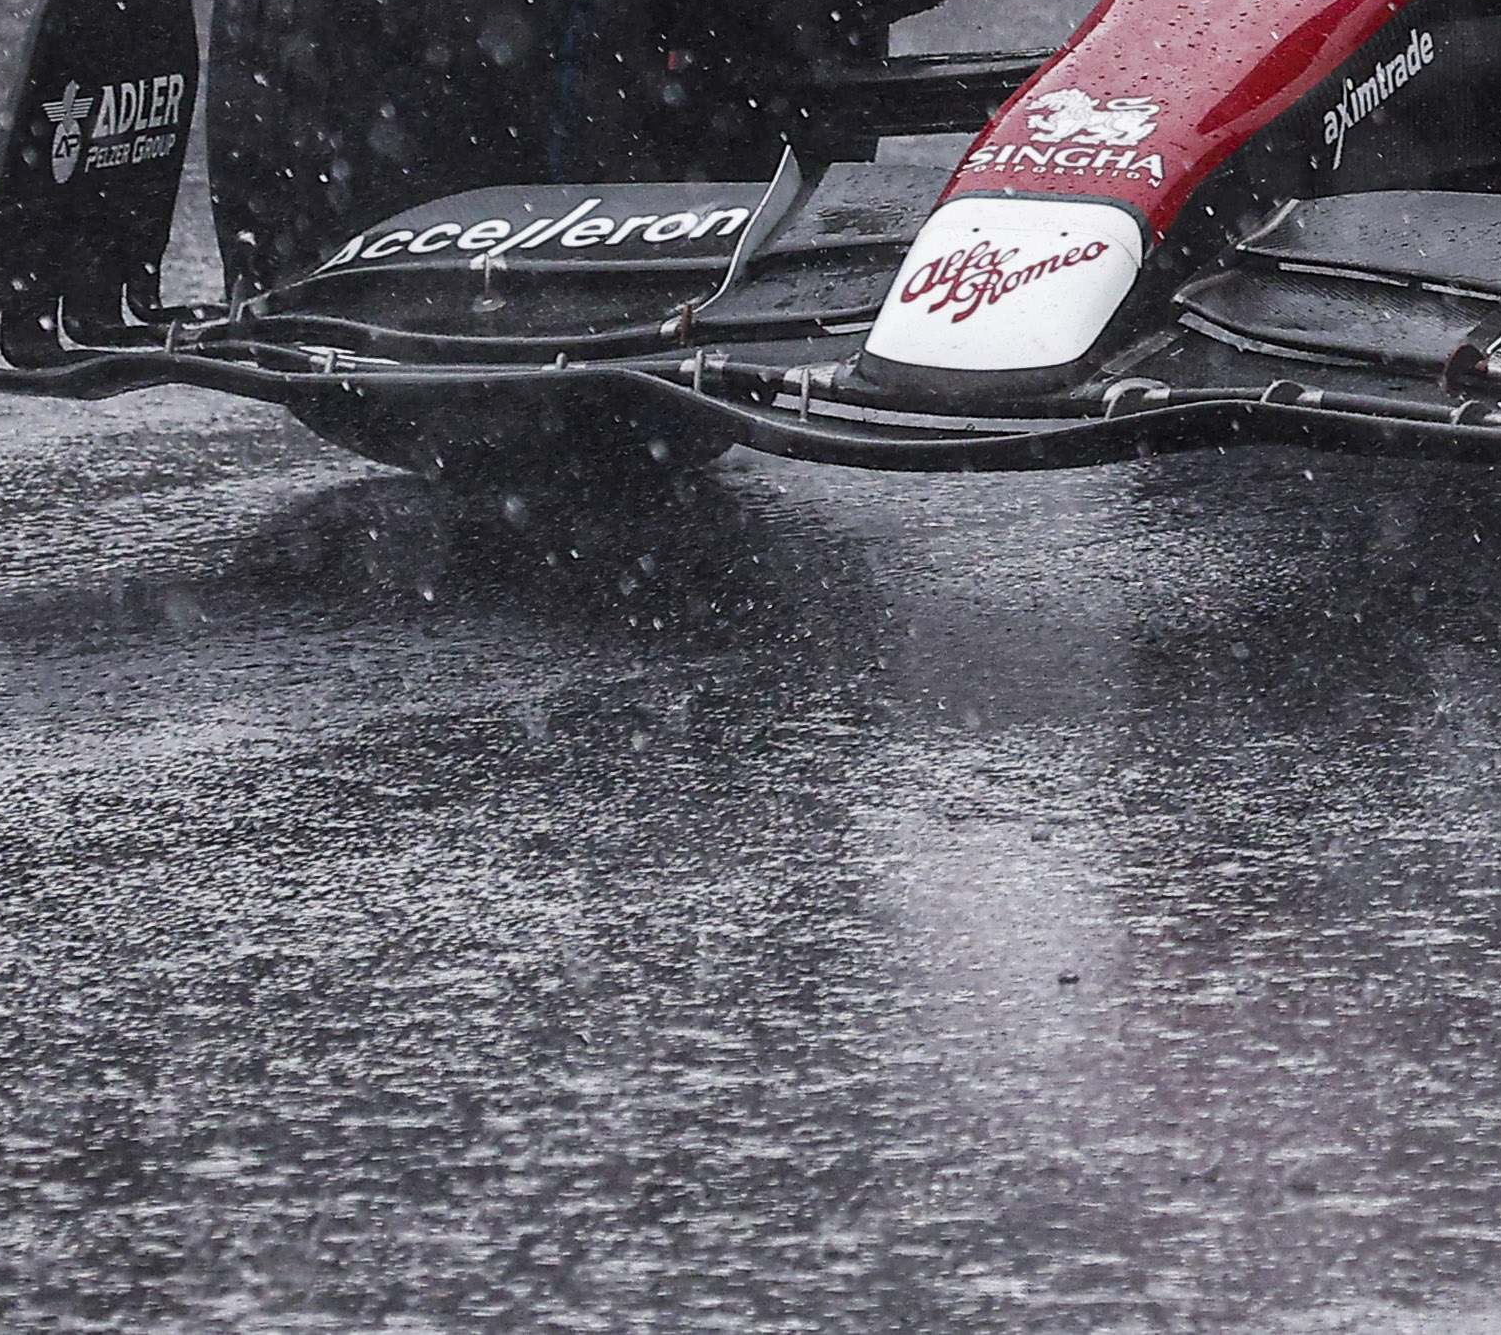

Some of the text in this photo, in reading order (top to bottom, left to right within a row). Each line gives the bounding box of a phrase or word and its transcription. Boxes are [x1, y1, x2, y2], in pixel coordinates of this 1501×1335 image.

[91, 73, 185, 139] ADLER
[1322, 27, 1436, 171] aximtrade
[955, 163, 1161, 189] CORPORATION
[962, 144, 1166, 181] SINGHA
[950, 241, 1110, 324] Romeo
